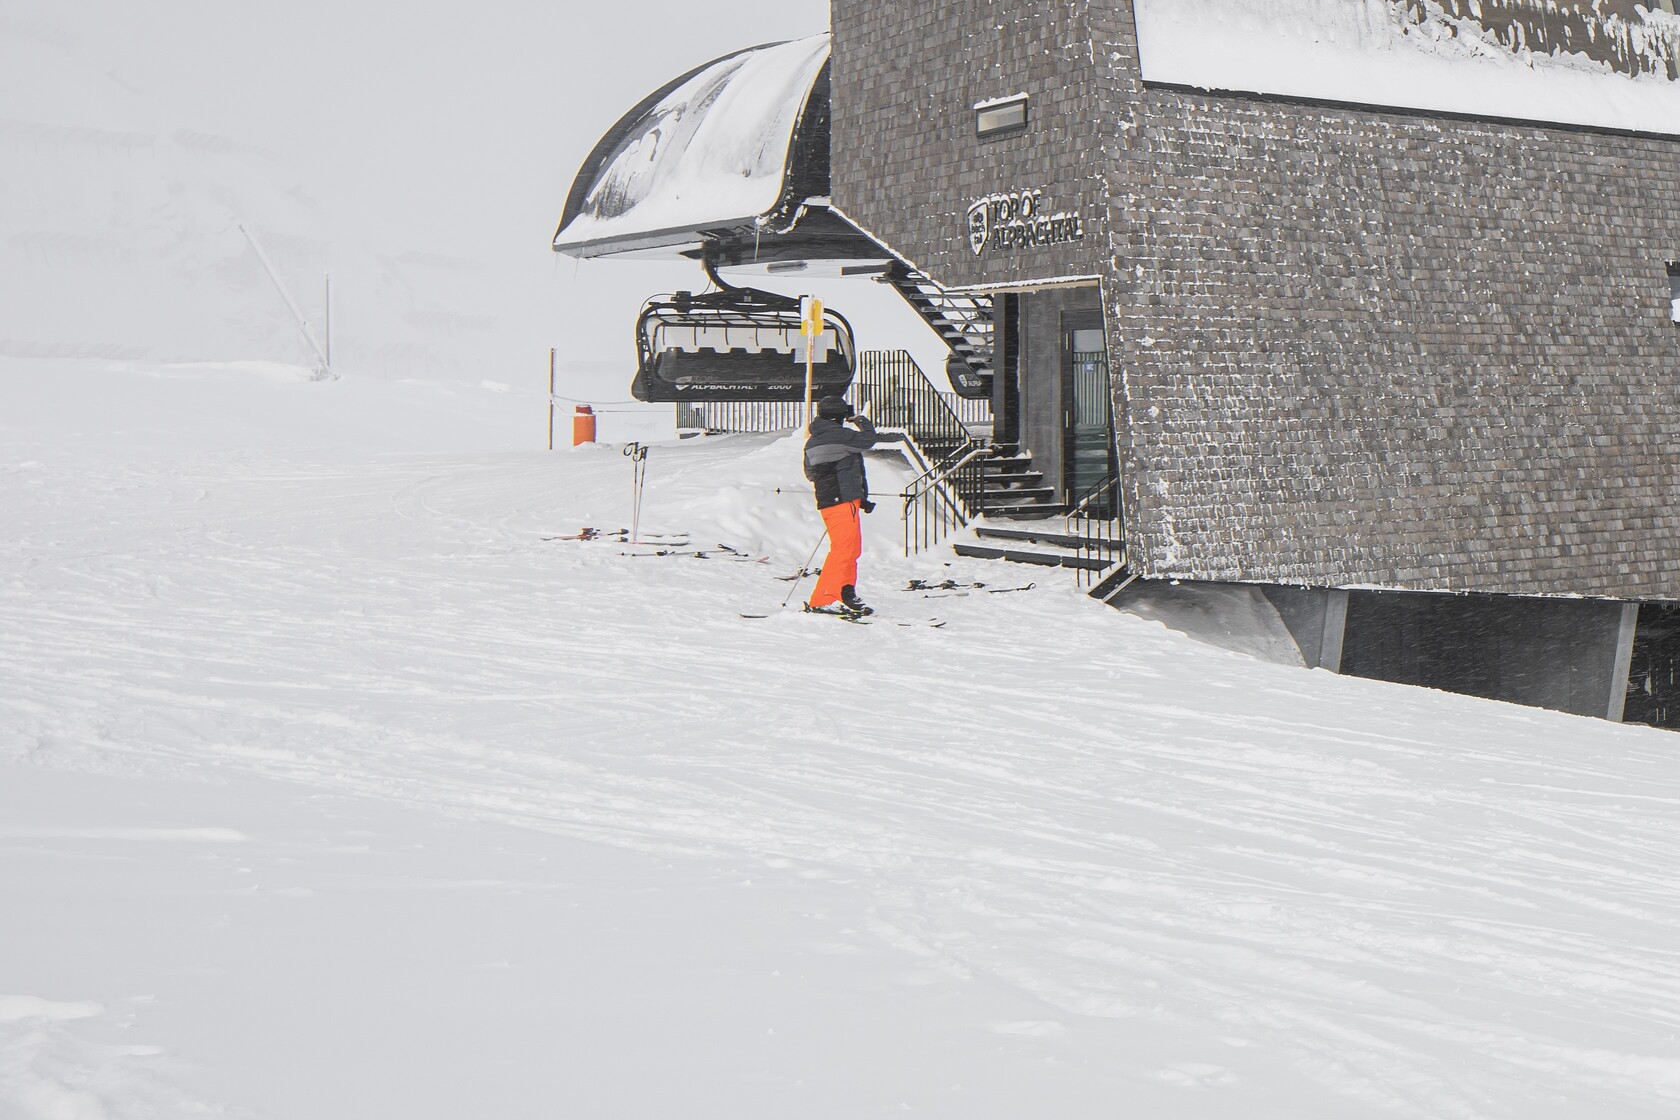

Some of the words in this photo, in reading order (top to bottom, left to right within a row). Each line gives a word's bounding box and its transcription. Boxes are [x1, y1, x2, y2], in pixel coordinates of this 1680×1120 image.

[991, 195, 1018, 222] TOP
[1021, 192, 1041, 218] OF
[992, 216, 1083, 250] ALPBACHTAL
